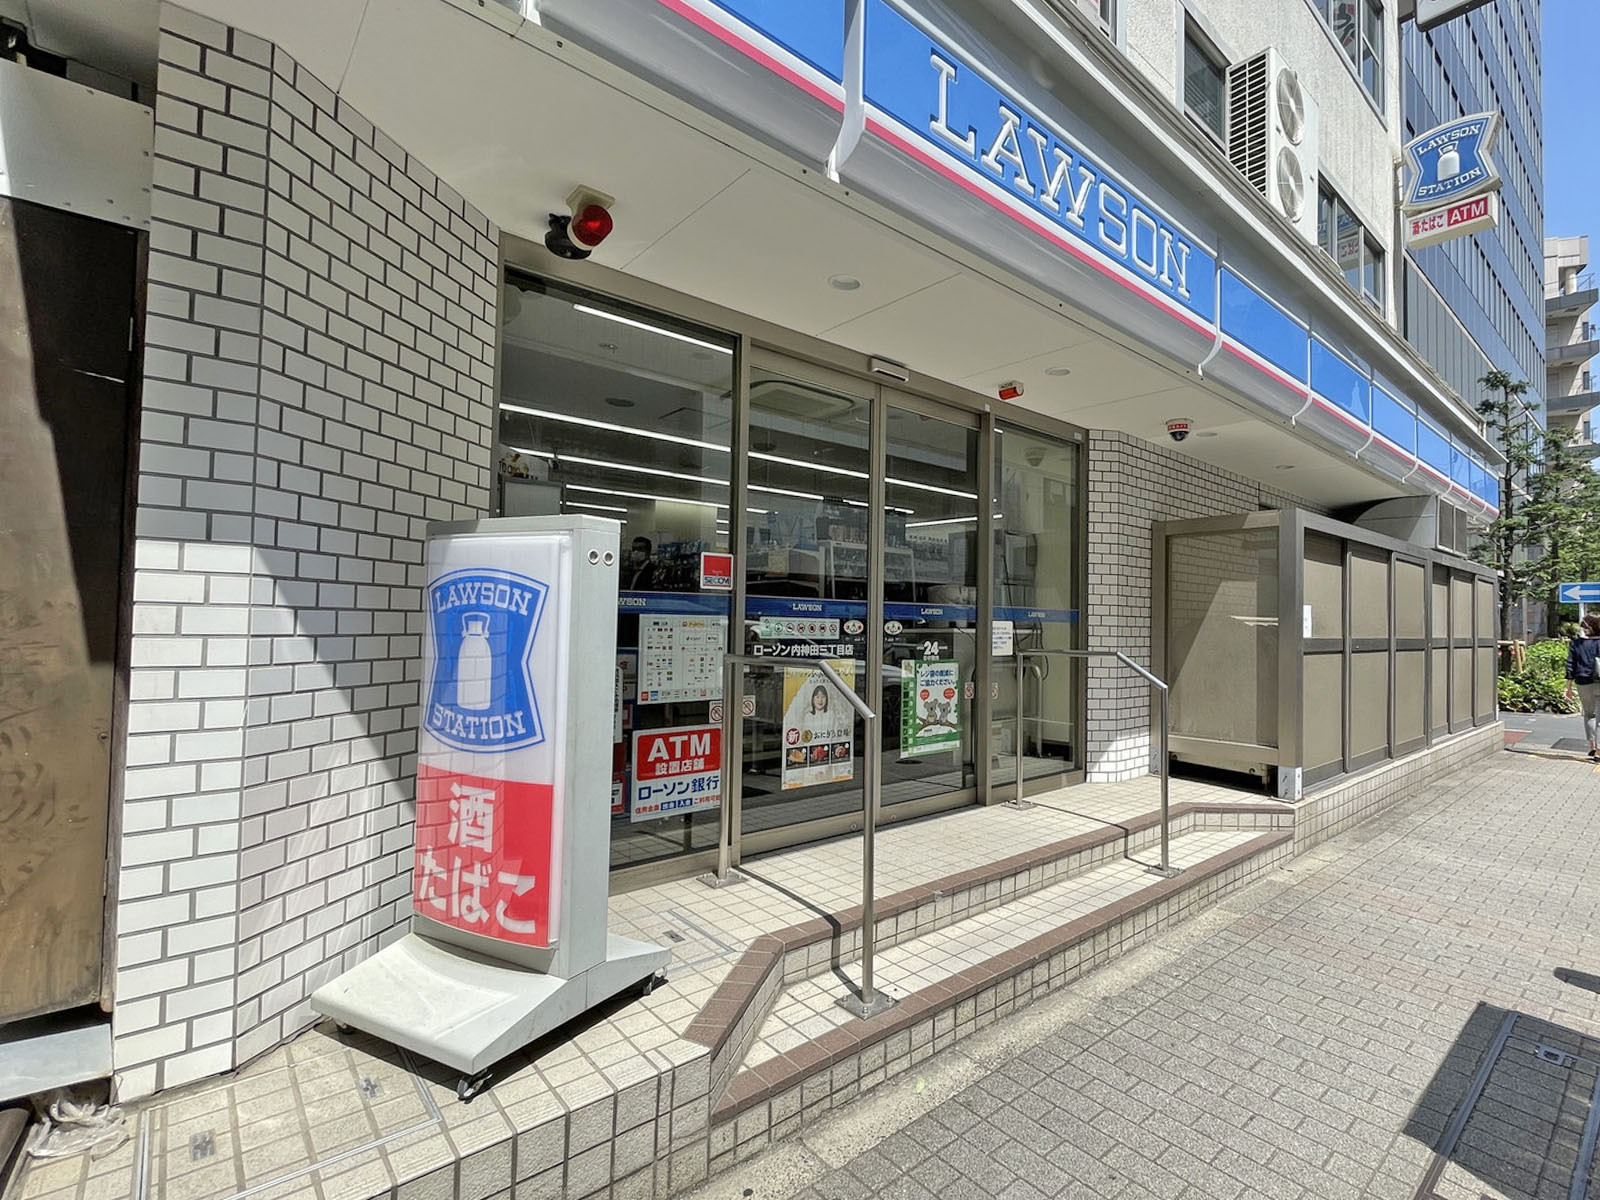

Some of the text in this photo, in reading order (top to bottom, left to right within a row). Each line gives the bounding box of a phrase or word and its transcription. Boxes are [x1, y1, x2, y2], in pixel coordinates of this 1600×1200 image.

[1416, 124, 1482, 156] LAWSON
[929, 52, 1191, 299] LAWSON
[1417, 166, 1483, 197] STATION
[1450, 201, 1485, 224] ATM
[434, 582, 532, 616] LAWSON
[923, 640, 939, 655] 24
[432, 703, 526, 740] STATION
[647, 732, 711, 762] ATM
[638, 775, 720, 801] ローソン銀行
[448, 782, 496, 853] 酒
[419, 845, 536, 934] たばこ
